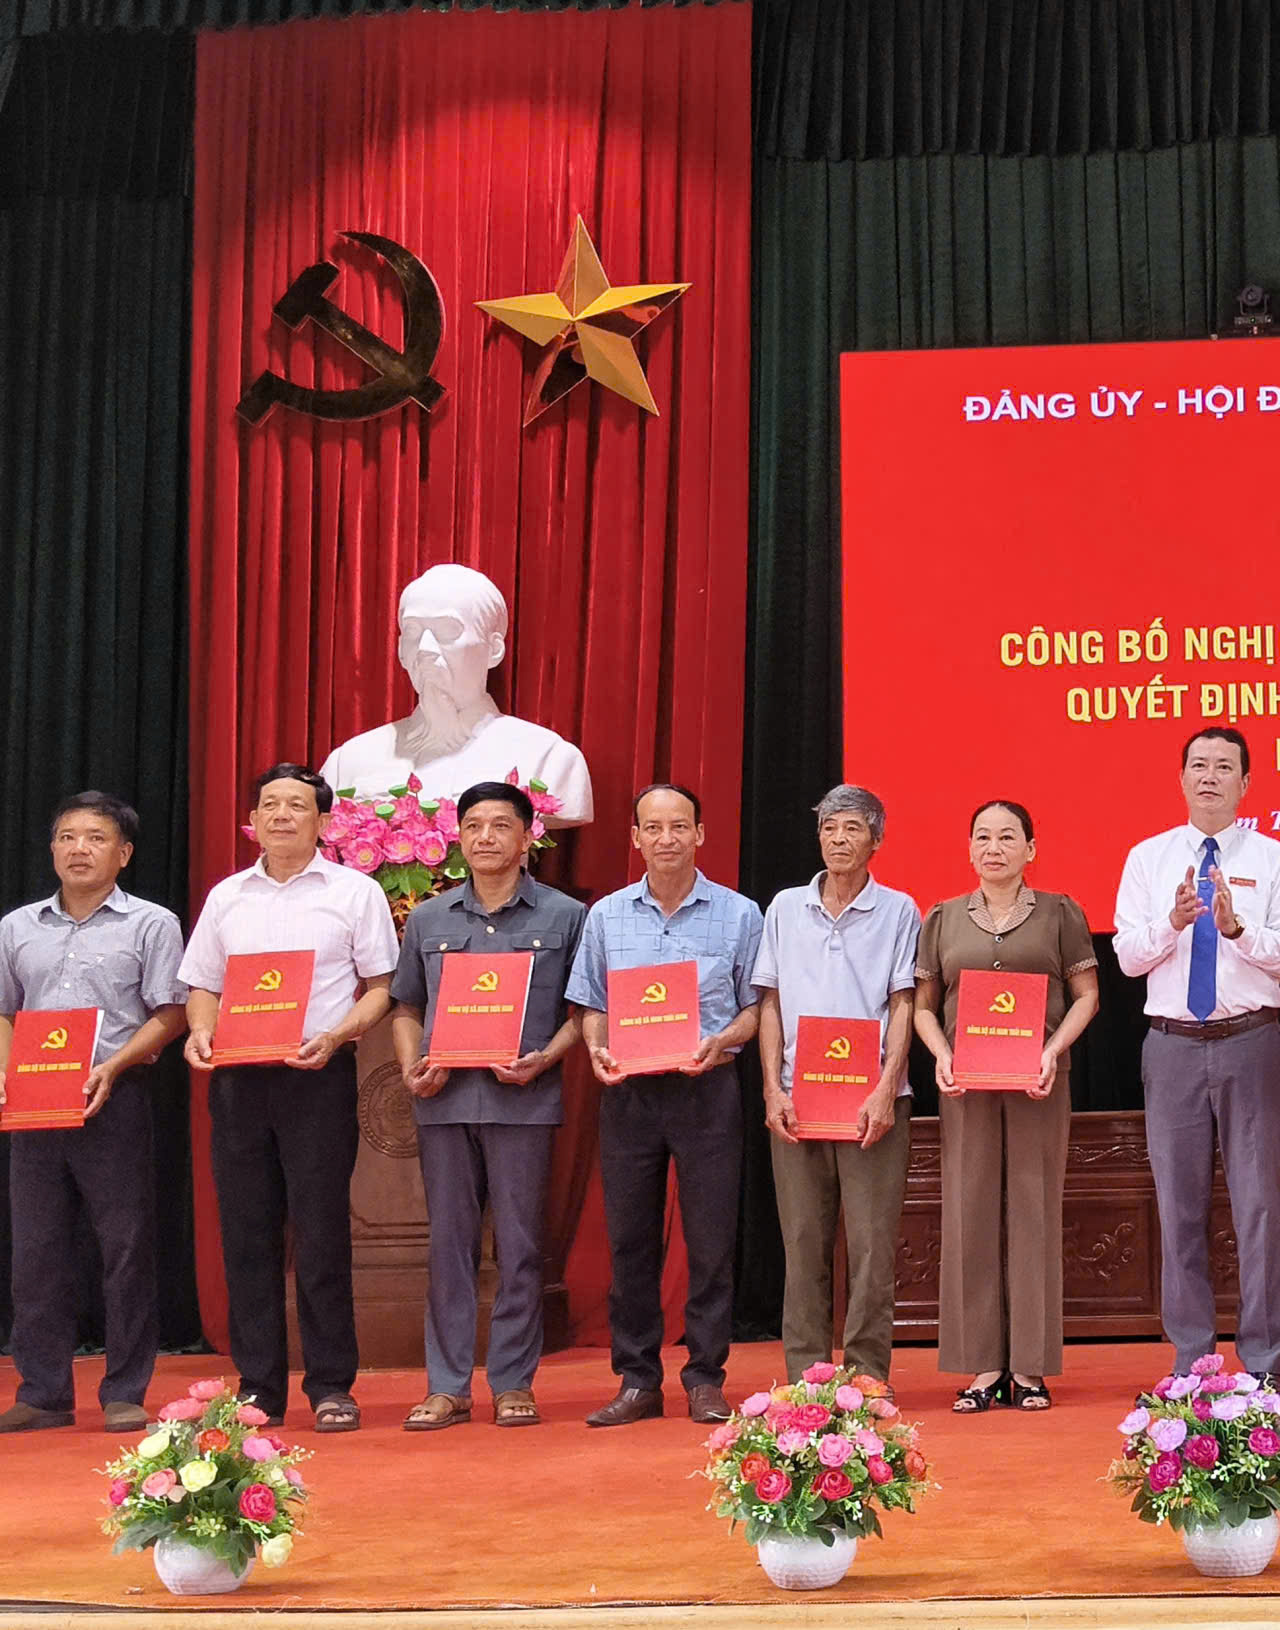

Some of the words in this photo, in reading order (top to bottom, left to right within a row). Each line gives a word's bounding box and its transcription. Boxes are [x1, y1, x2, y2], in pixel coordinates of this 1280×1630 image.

[963, 390, 1075, 421] ĐẢNG
[1091, 386, 1142, 417] ỦY
[1179, 385, 1244, 418] HỘI
[1001, 626, 1103, 666] CÔNG
[1119, 617, 1168, 662] BỐ
[1185, 626, 1274, 664] NGHỊ
[1067, 674, 1188, 722] QUYẾT
